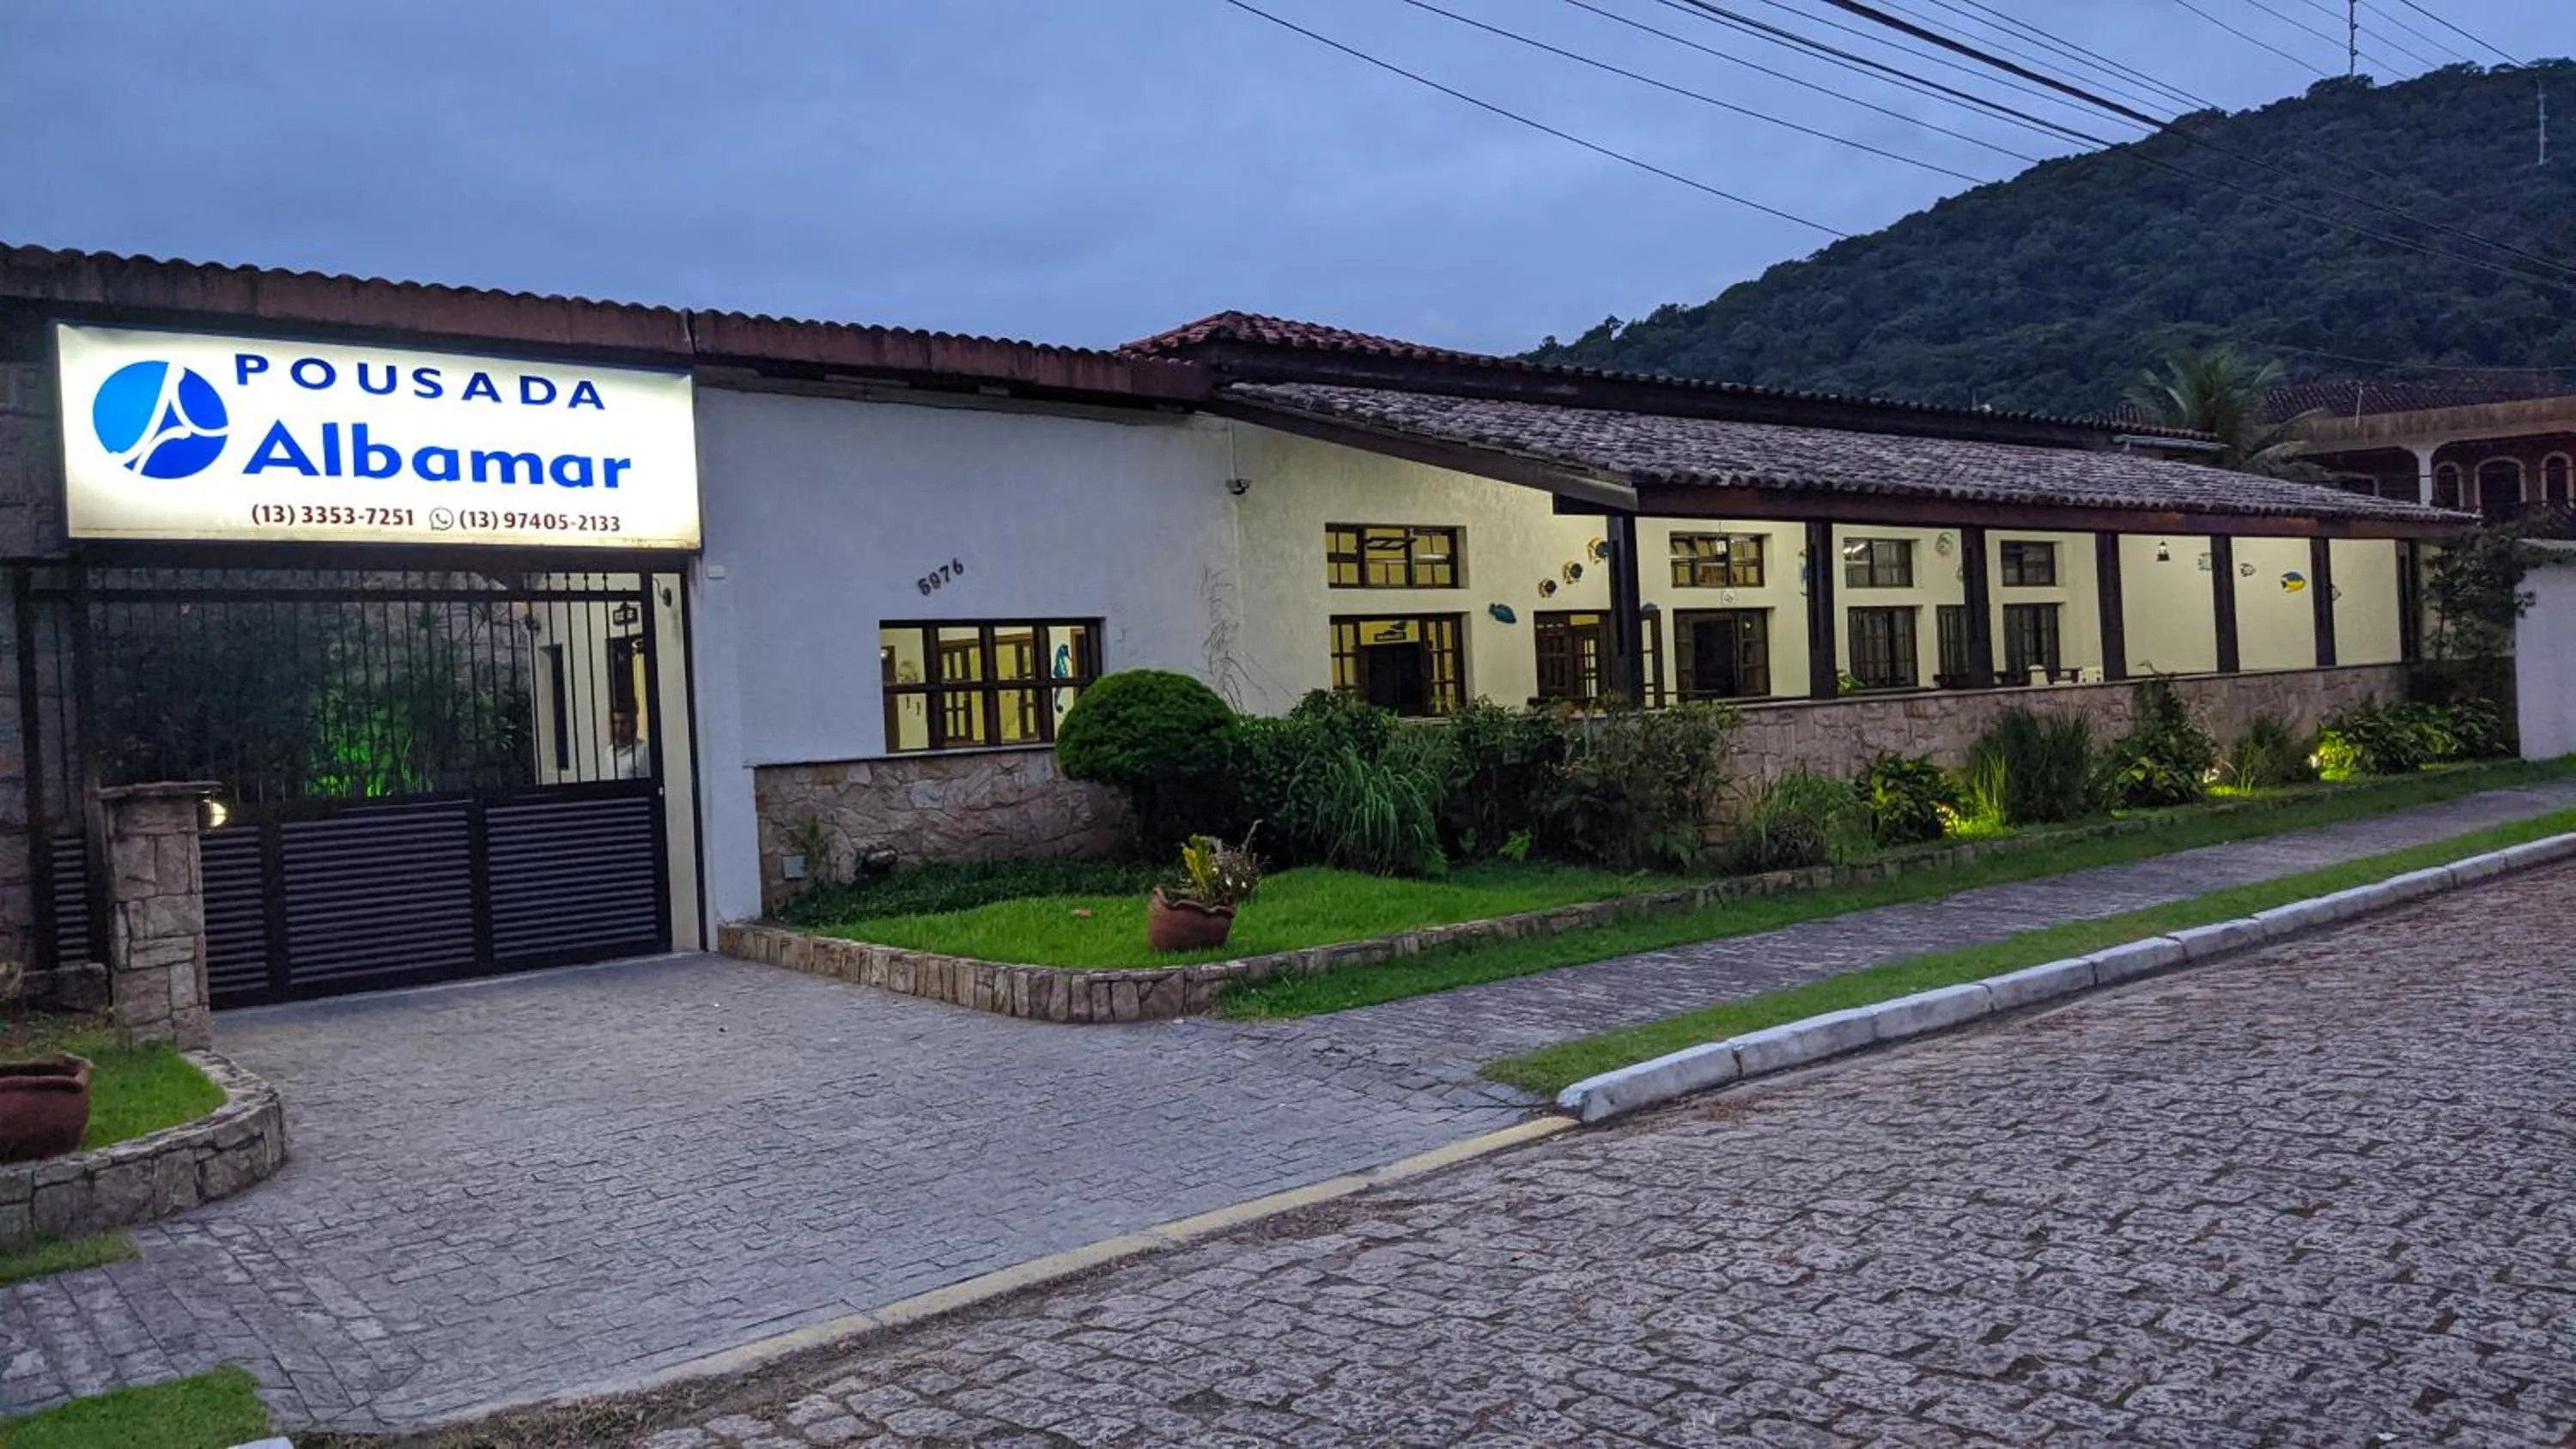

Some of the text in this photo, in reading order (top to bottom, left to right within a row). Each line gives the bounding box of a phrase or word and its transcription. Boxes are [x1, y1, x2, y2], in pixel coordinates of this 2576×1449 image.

[235, 354, 605, 409] POUSADA
[242, 420, 631, 488] Albamar
[252, 505, 413, 526] (13) 3353-7251
[459, 511, 620, 531] (13) 97405-2133
